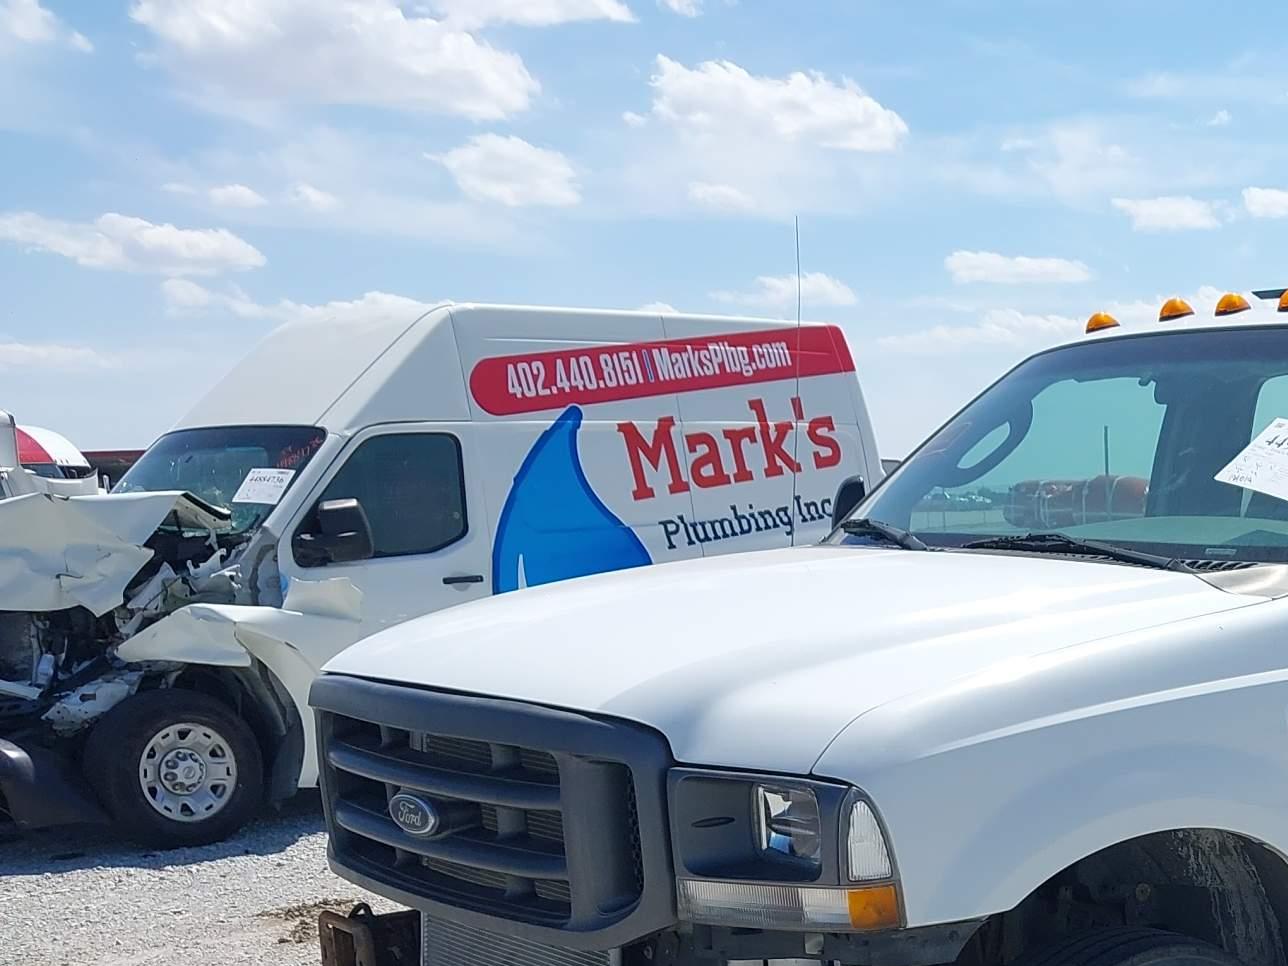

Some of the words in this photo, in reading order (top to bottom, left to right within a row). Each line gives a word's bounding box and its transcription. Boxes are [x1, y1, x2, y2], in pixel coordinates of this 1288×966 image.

[506, 350, 642, 400] 402.440.8151
[655, 341, 792, 382] MarksPlbg.com
[616, 396, 842, 501] Mark's
[659, 502, 793, 549] Plumbing
[399, 801, 422, 826] Ford
